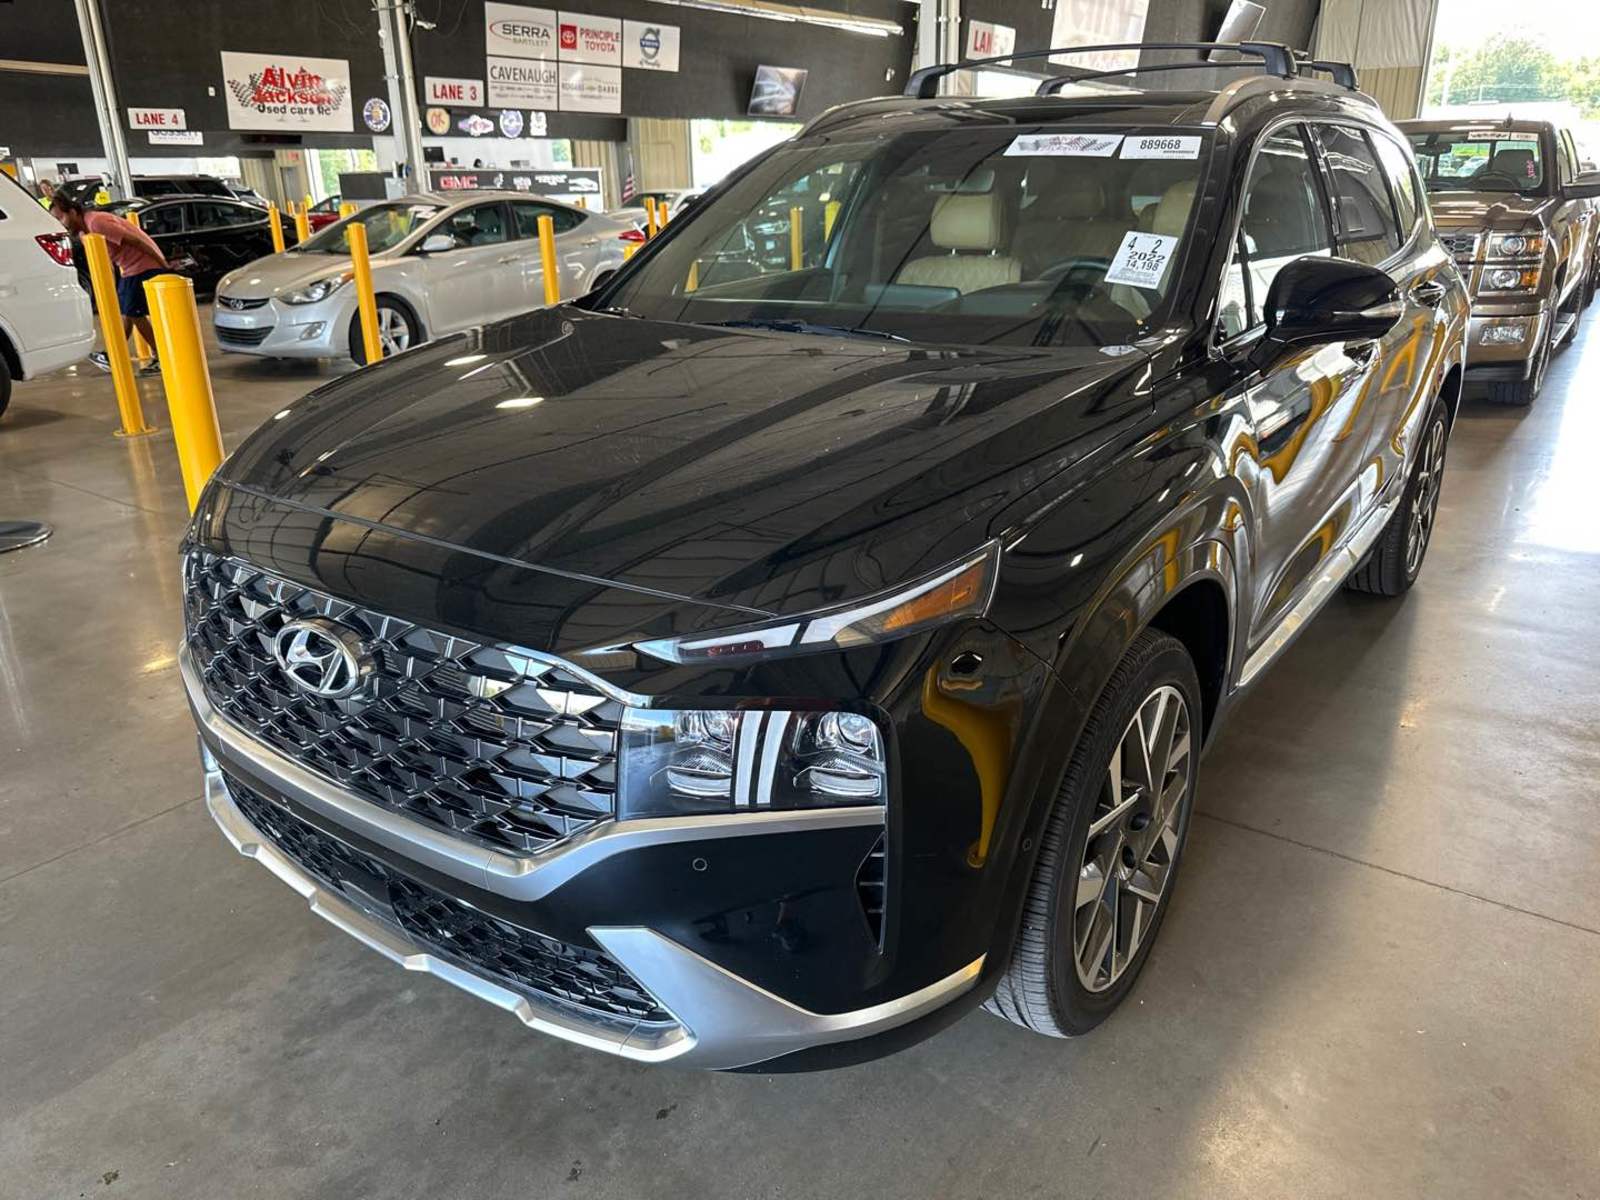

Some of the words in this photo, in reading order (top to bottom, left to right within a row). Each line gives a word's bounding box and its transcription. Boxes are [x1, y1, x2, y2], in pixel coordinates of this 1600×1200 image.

[502, 23, 551, 39] SERRA
[579, 27, 620, 42] PRINCIPLE
[585, 40, 616, 53] TOYOTA
[262, 66, 324, 89] Alvin
[489, 65, 557, 84] CAVENAUGH
[252, 88, 333, 105] Jackson
[432, 84, 464, 100] LANE
[469, 86, 477, 101] 3
[257, 104, 287, 114] Used
[290, 106, 314, 115] cars
[135, 112, 166, 125] LANE
[171, 113, 179, 125] 4
[1139, 139, 1182, 150] 889668
[439, 175, 478, 189] GMC
[1127, 236, 1138, 251] 4
[1151, 239, 1163, 254] 2
[1128, 250, 1166, 264] 2022
[1126, 259, 1160, 272] 14,198
